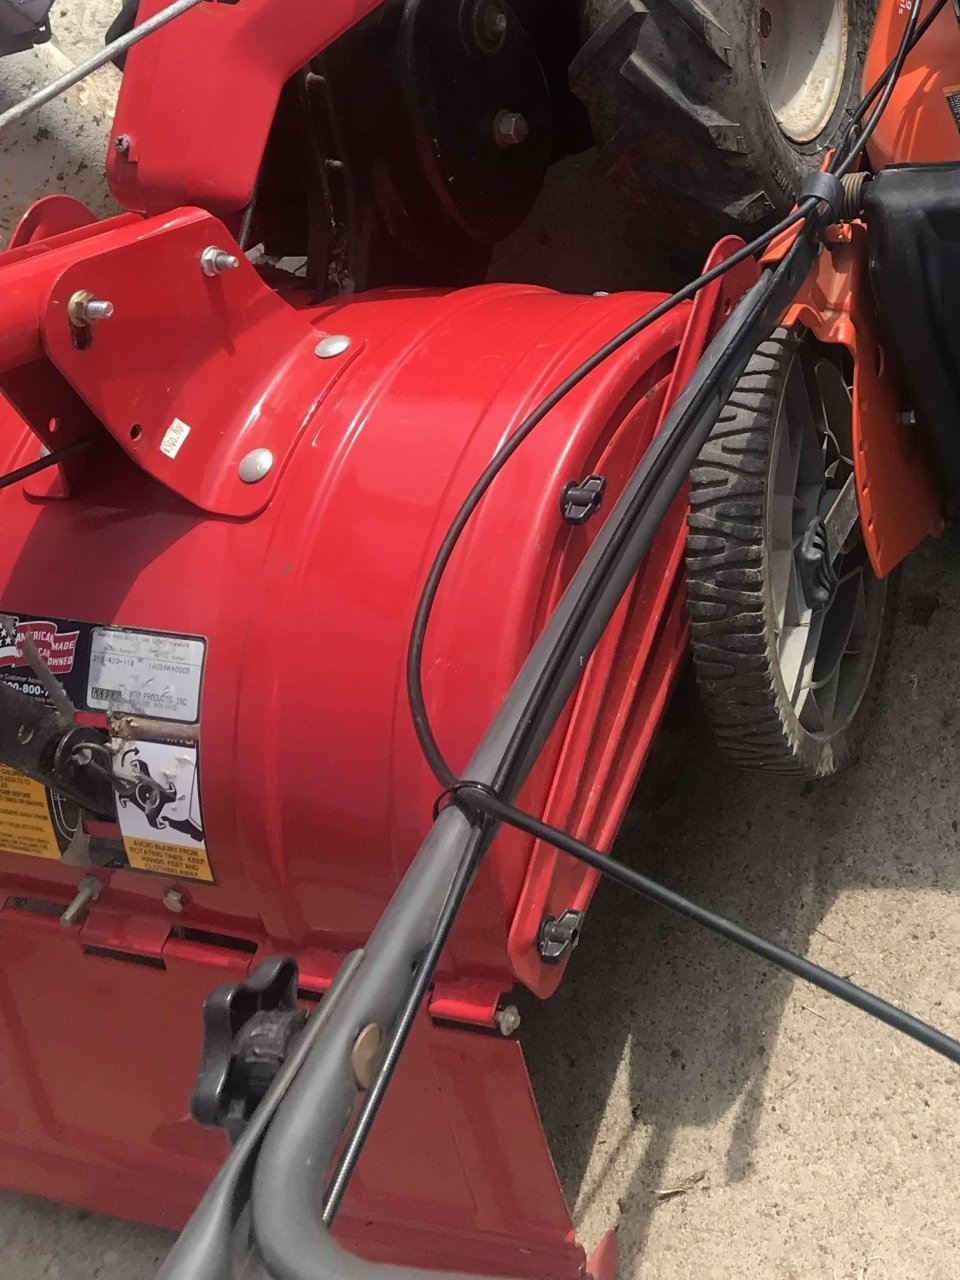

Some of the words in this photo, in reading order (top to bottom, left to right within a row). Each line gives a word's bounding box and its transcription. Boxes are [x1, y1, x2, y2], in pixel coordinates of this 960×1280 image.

[51, 640, 76, 651] MADE
[47, 656, 73, 666] OWNED
[143, 692, 173, 704] PRODUCTS
[176, 697, 188, 706] INC
[130, 846, 163, 858] ROTATING
[133, 840, 154, 849] AVOID
[155, 842, 177, 852] INJURY
[179, 846, 198, 856] FROM
[145, 864, 178, 874] CLOTHING
[179, 869, 198, 877] AWAY
[167, 860, 184, 868] FEET
[186, 862, 199, 870] AND
